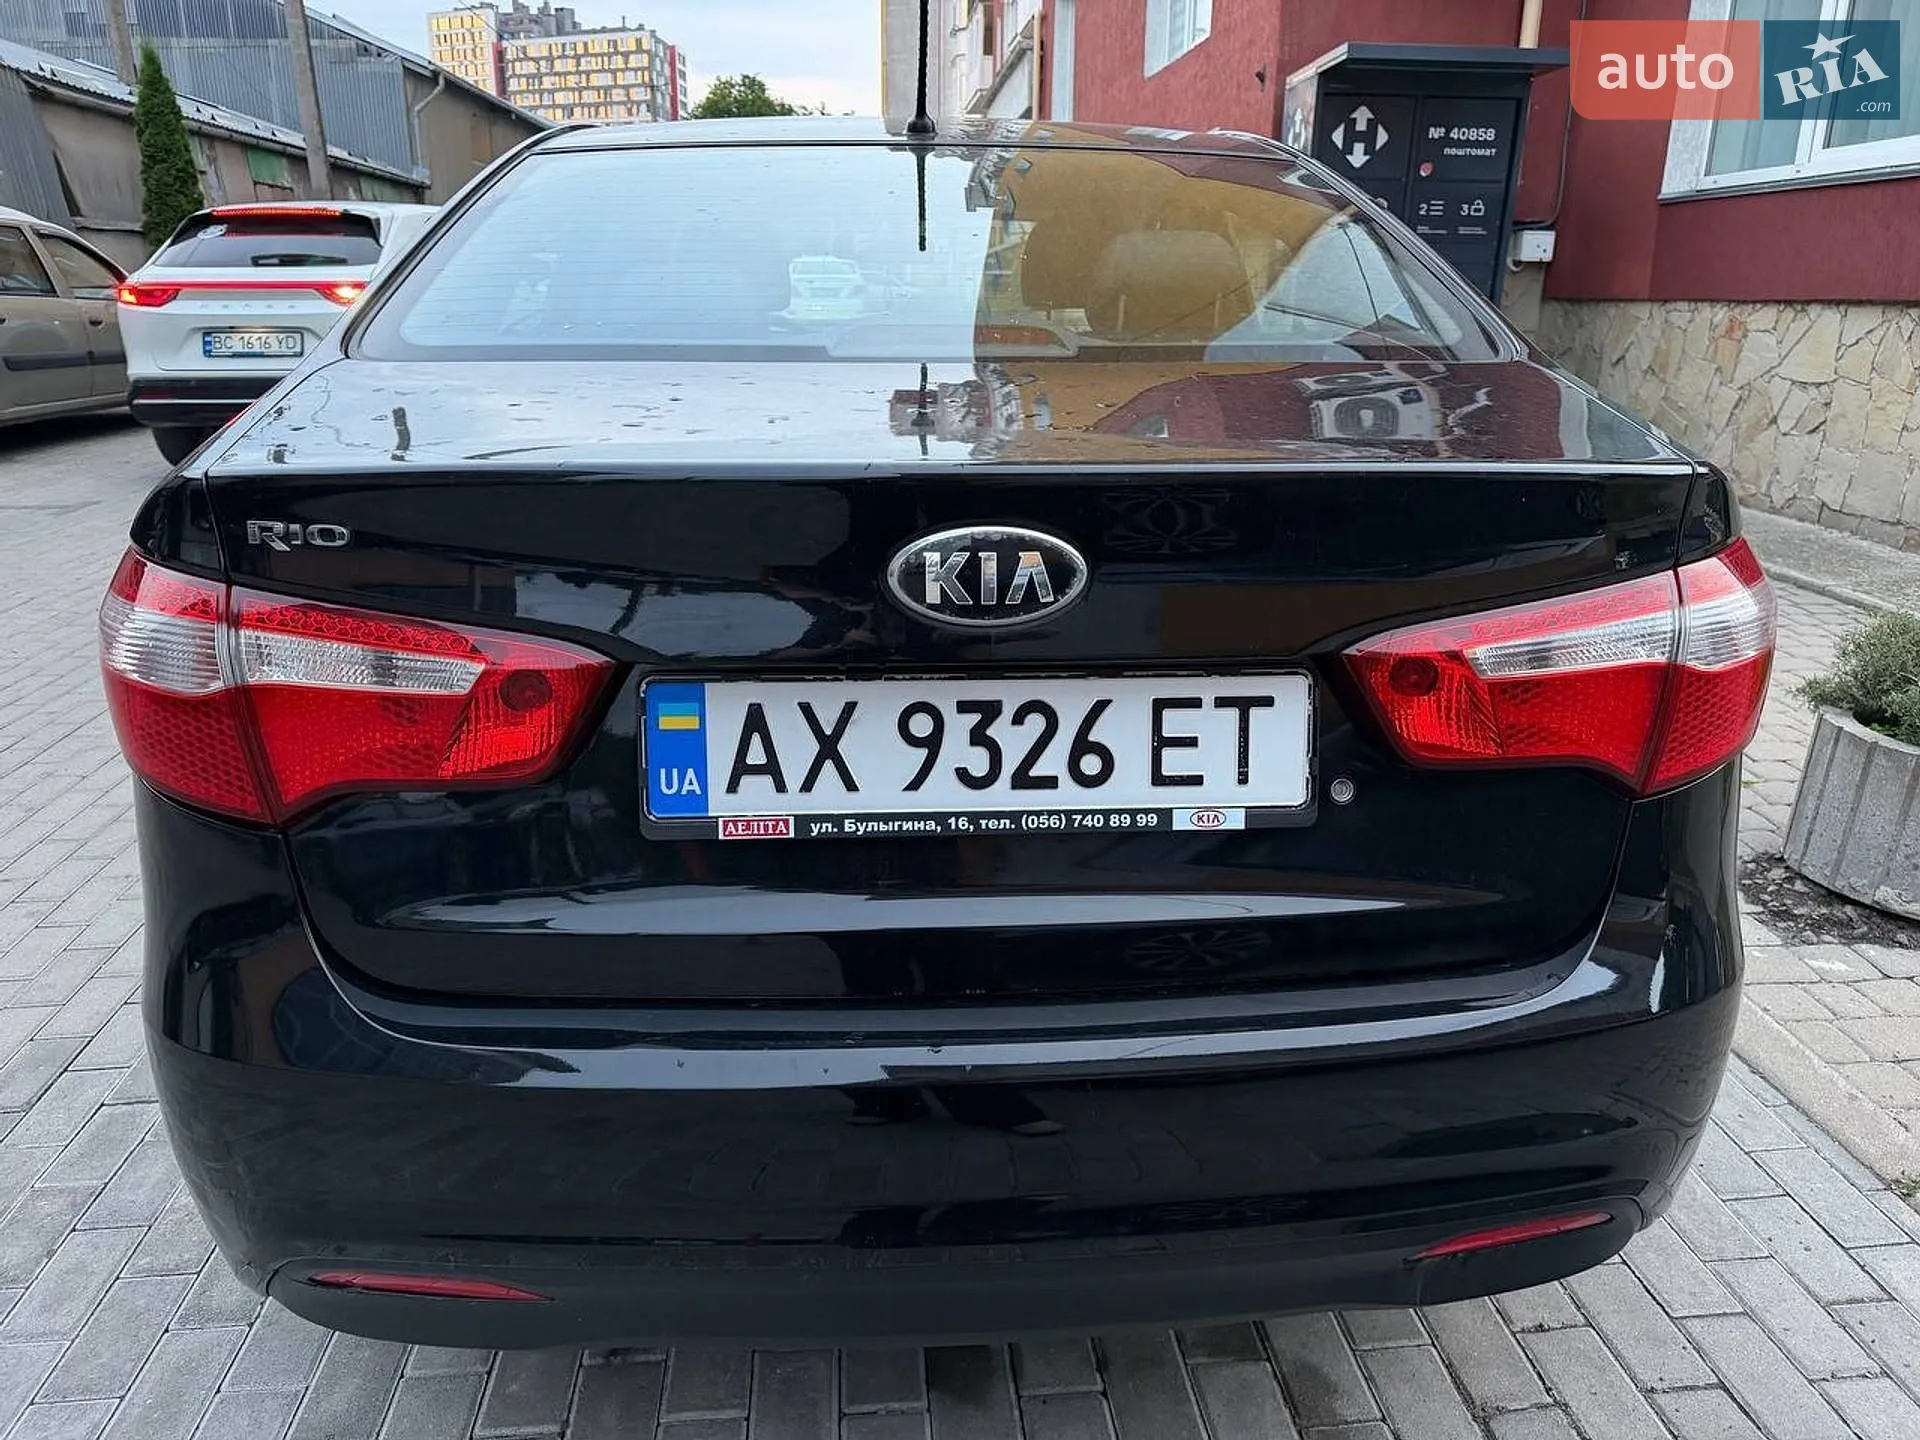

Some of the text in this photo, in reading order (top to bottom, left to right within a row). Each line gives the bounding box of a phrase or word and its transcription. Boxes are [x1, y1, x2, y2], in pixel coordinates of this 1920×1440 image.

[1449, 127, 1496, 141] 40858
[1443, 147, 1497, 156] поштомат
[1419, 203, 1428, 215] 2
[1460, 204, 1469, 216] 3
[239, 336, 272, 349] 1616
[246, 520, 350, 551] RIO
[923, 551, 1054, 605] KIA
[725, 695, 1275, 794] AX 9326 ET
[659, 768, 702, 796] UA
[810, 812, 1158, 836] ул. Булыгина, 16, тел. (056) 740 89 99
